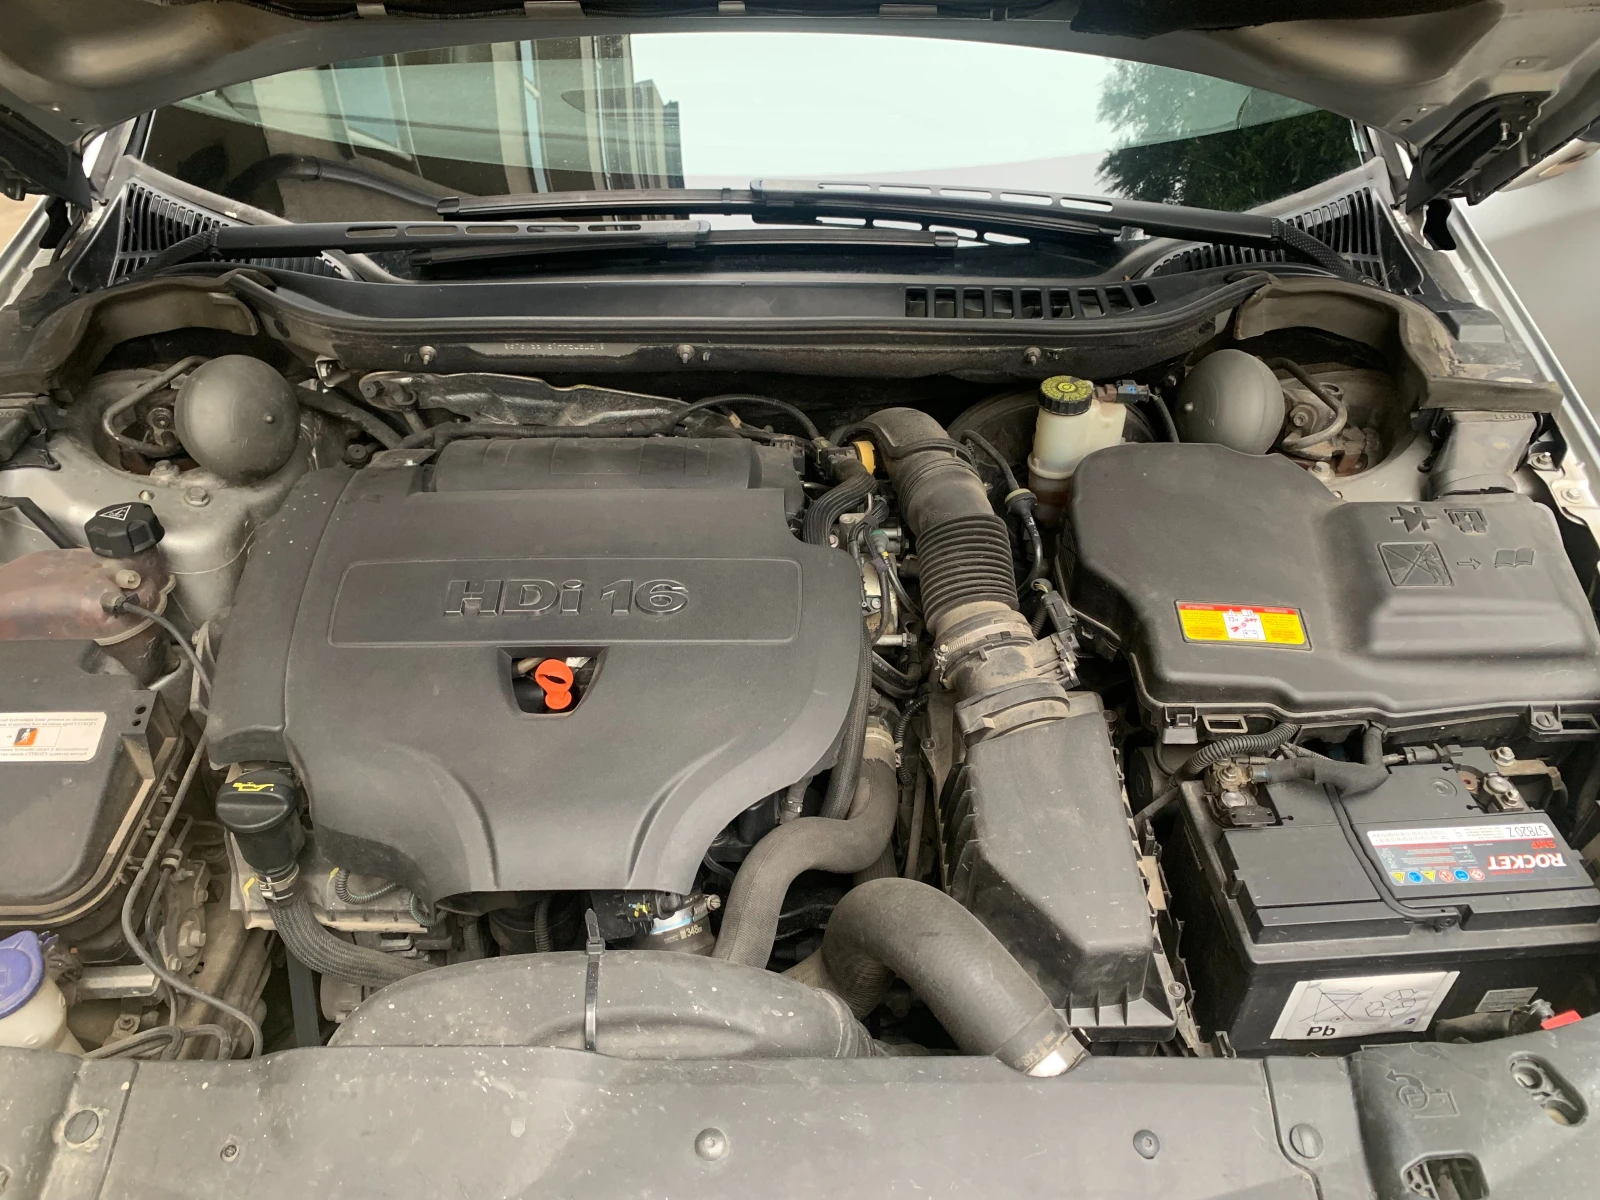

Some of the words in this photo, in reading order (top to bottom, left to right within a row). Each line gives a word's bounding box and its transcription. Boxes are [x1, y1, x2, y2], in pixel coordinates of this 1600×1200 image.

[443, 578, 585, 616] HDi
[600, 578, 690, 616] 16
[1530, 840, 1557, 850] SMF
[1487, 852, 1567, 871] ROCKET
[1306, 1026, 1336, 1037] Pb
